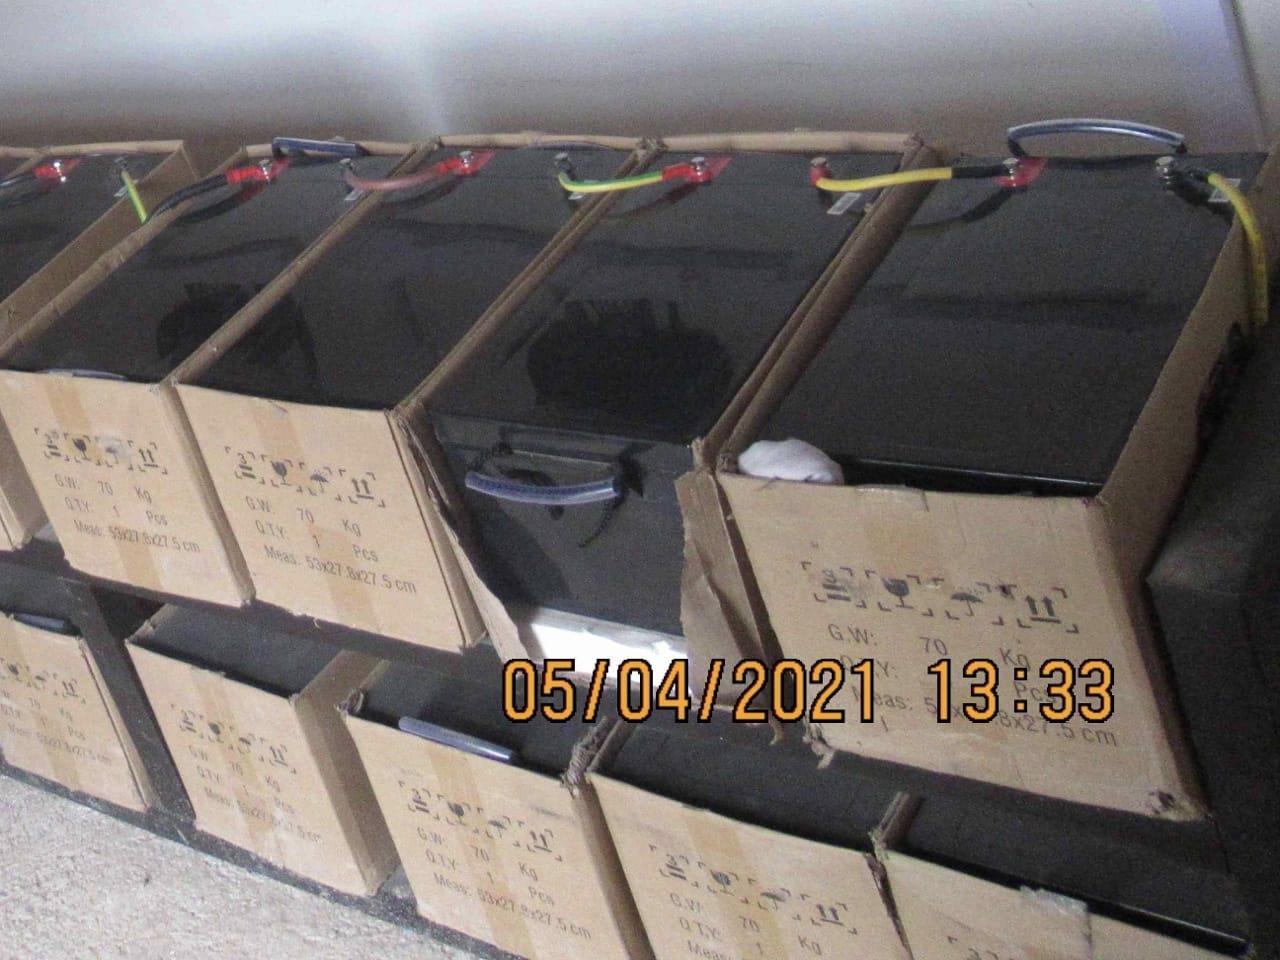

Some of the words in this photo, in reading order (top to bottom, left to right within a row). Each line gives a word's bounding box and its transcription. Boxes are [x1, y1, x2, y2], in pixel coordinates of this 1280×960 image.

[97, 480, 114, 496] 70
[134, 486, 153, 504] Kg
[145, 510, 168, 526] Pcs
[296, 508, 315, 523] 70
[342, 519, 361, 537] Kg
[352, 544, 379, 562] Pcs
[828, 623, 878, 646] G.W:
[920, 636, 948, 656] 70
[999, 647, 1031, 672] Kg
[471, 844, 490, 862] 70
[518, 861, 539, 882] Kg
[739, 915, 760, 933] 70
[797, 935, 822, 955] Kg
